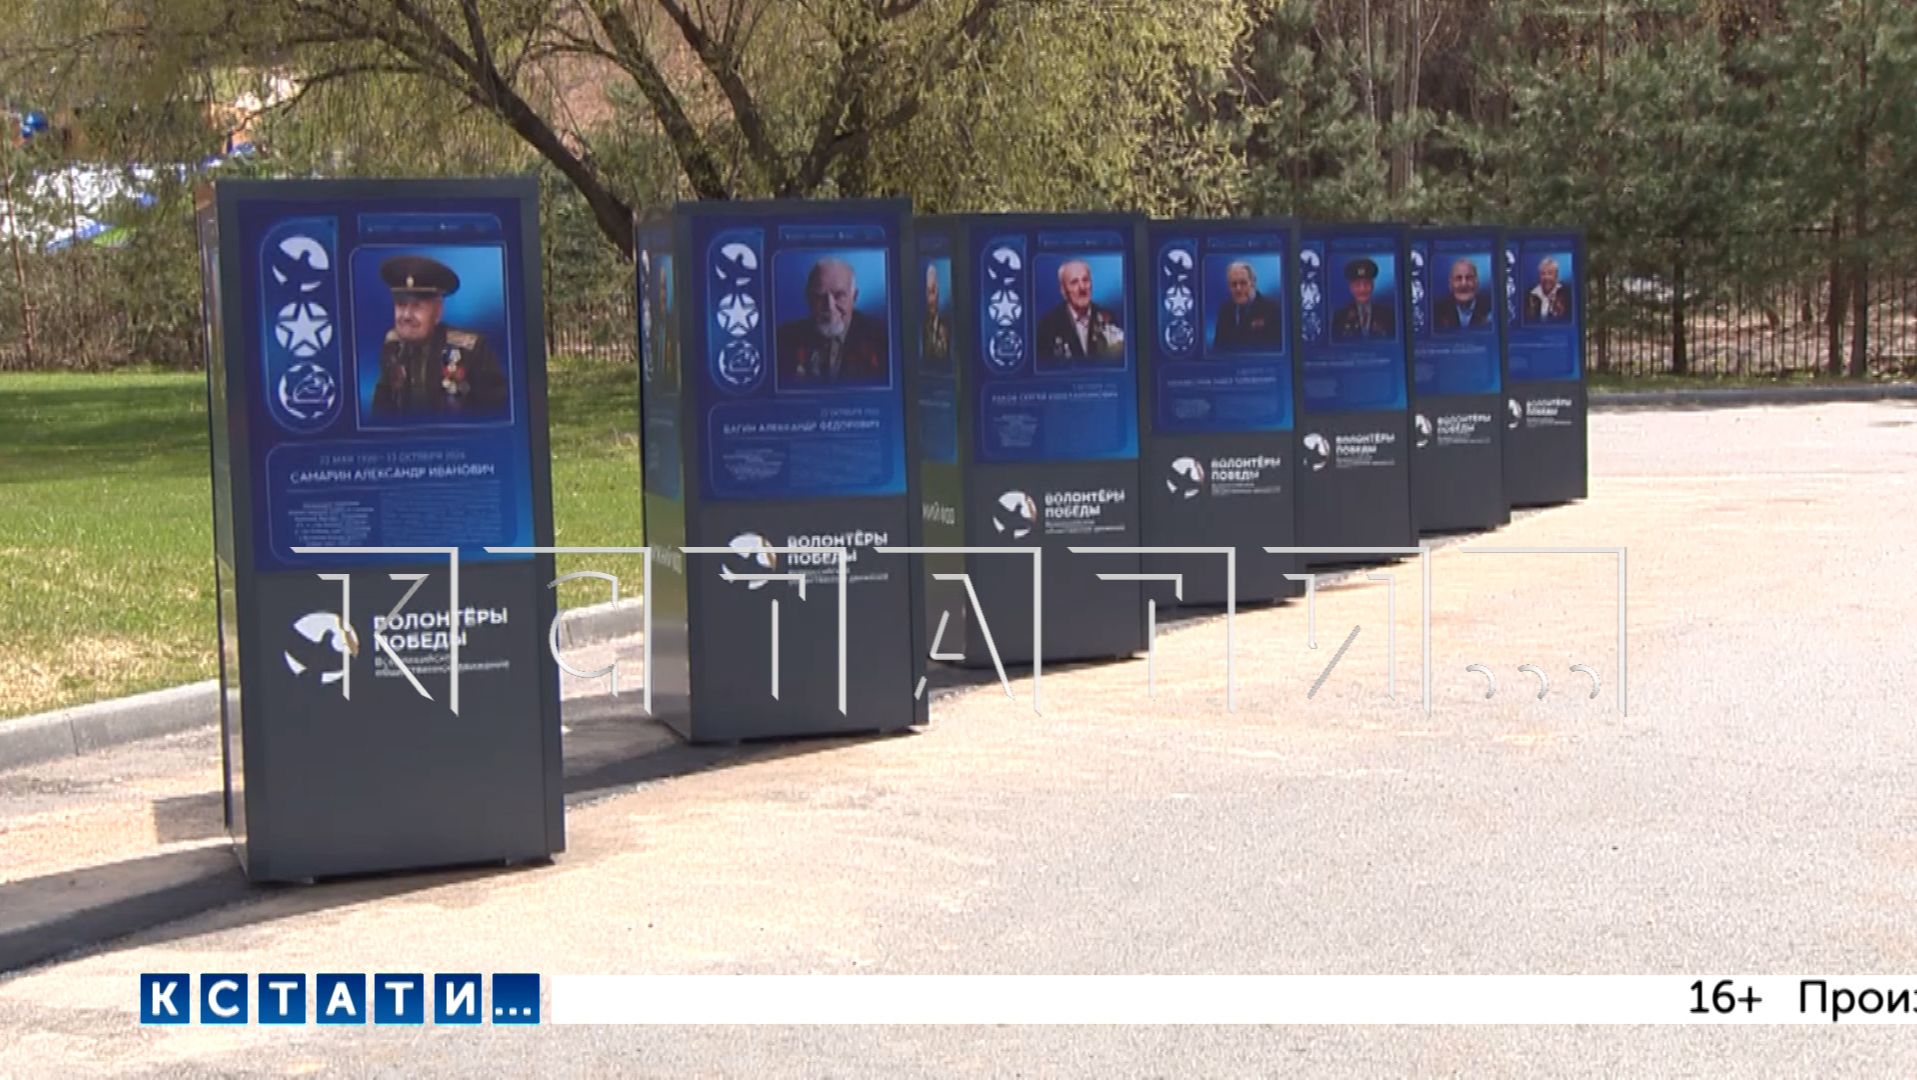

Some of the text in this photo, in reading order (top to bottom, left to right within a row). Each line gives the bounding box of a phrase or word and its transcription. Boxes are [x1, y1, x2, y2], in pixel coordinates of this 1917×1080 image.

[289, 463, 496, 484] САМАРИН АЛЕКСАНДР ИВАНОВИЧ
[1045, 488, 1125, 506] ВОЛОНТЁРЫ
[1045, 504, 1101, 518] ПОБЕДЫ
